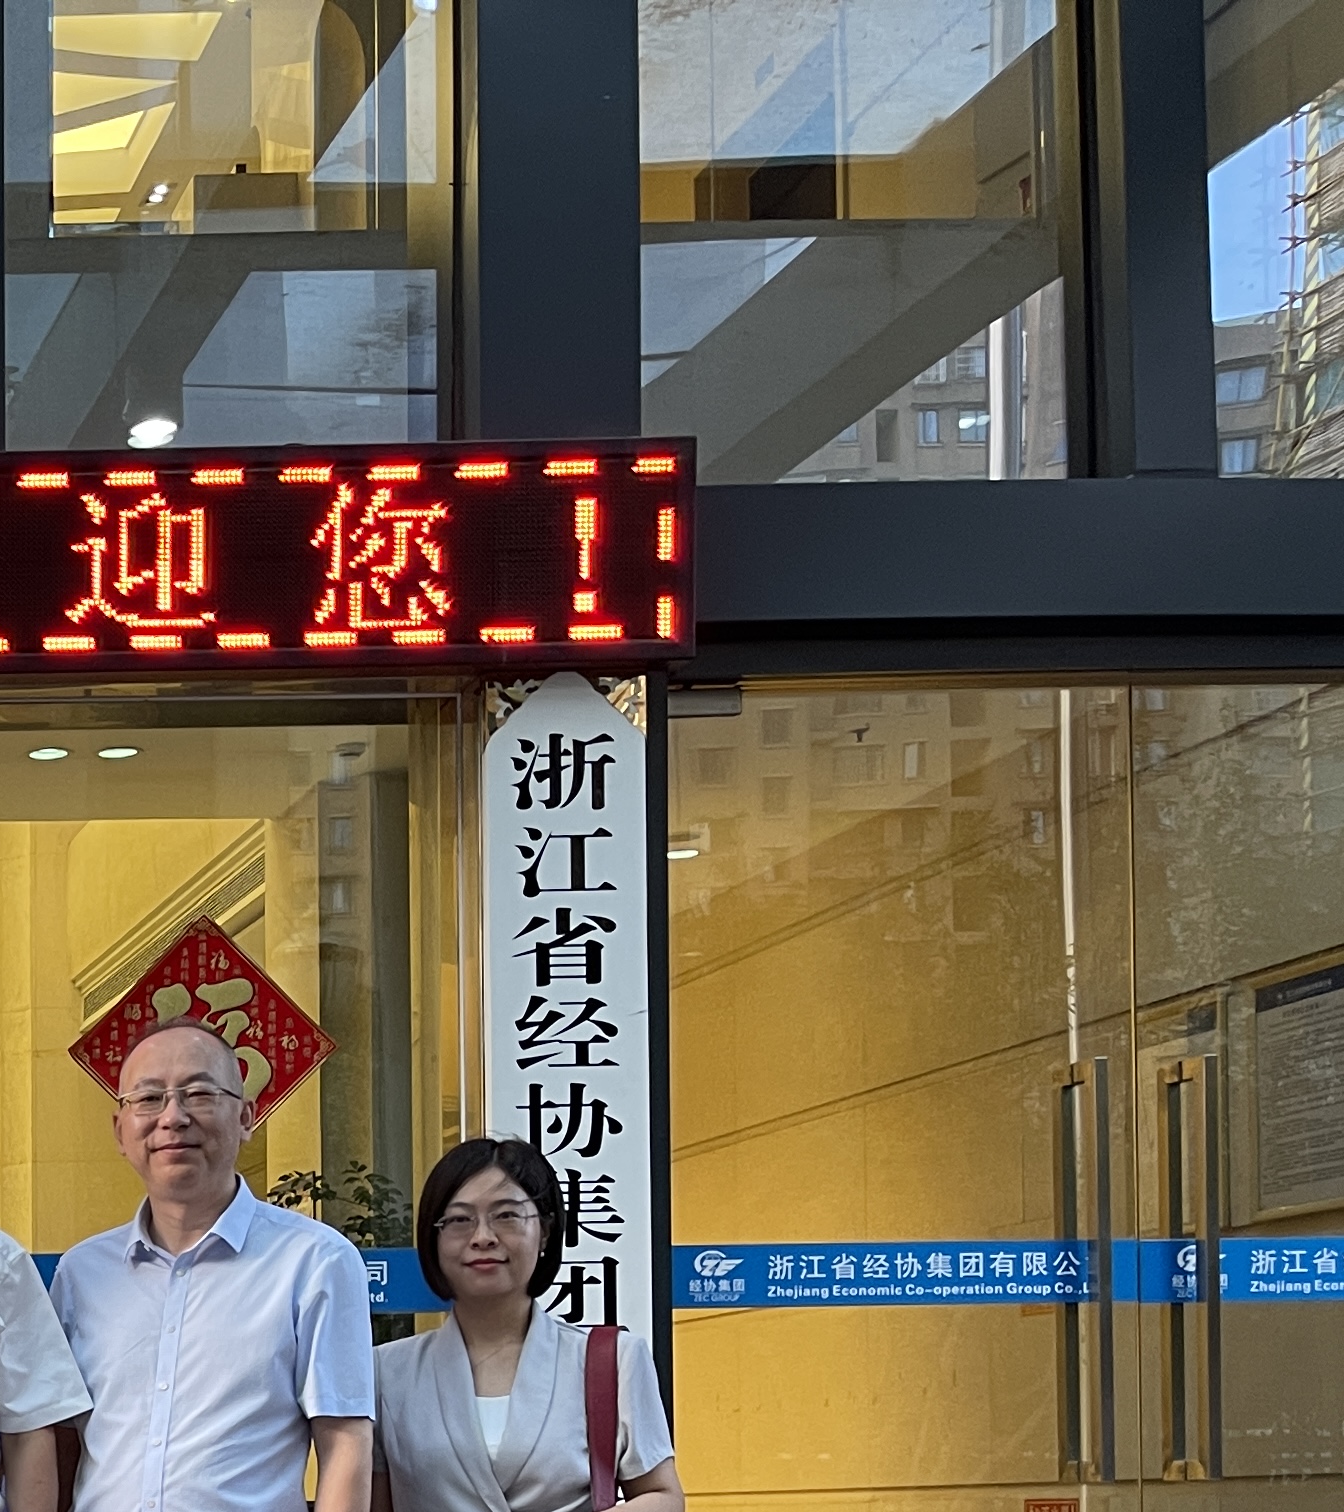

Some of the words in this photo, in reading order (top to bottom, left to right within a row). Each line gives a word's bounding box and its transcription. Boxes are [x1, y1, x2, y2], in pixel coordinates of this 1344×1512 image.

[767, 1251, 1089, 1280] 浙江省经协集团有限公
[1250, 1247, 1344, 1275] 浙江省
[689, 1278, 745, 1292] 经协集团
[767, 1285, 830, 1299] Zhejiang
[832, 1284, 903, 1297] Economic
[905, 1283, 1003, 1298] Co-operation
[1006, 1283, 1051, 1297] Group
[1250, 1280, 1312, 1294] Zhejiang
